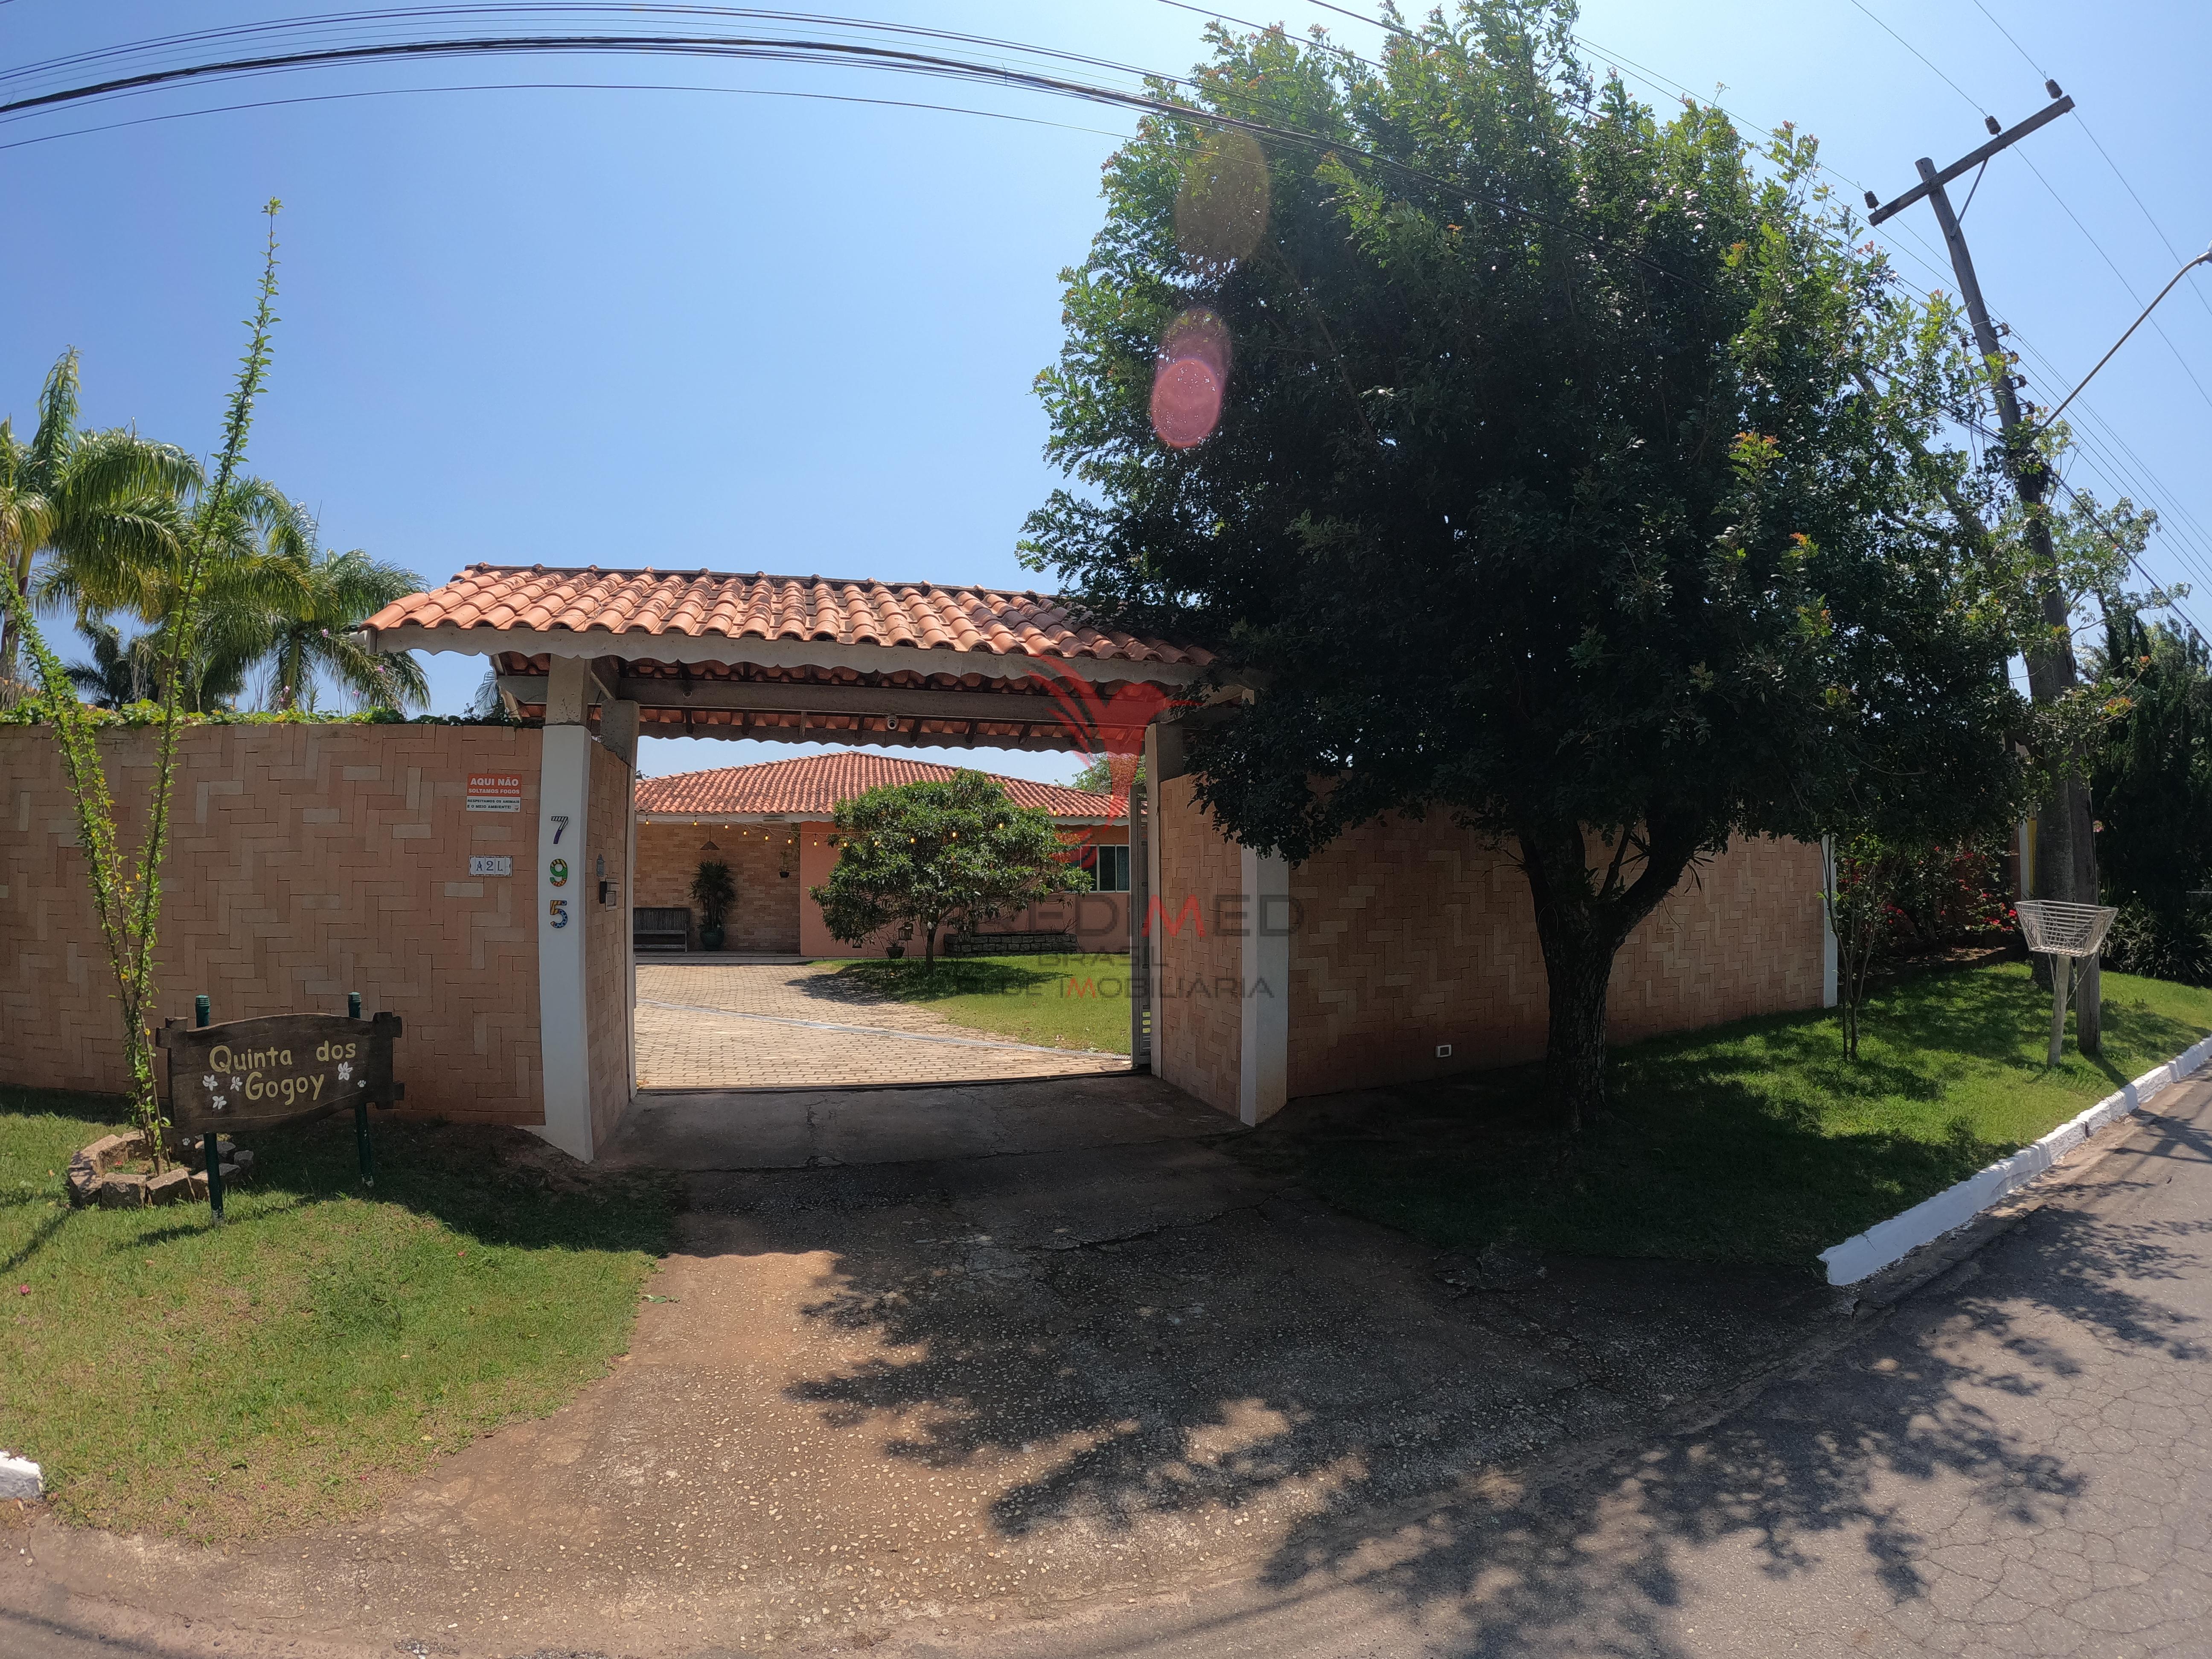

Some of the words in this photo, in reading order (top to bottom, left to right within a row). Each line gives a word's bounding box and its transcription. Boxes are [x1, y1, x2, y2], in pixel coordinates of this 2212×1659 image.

[470, 777, 495, 786] AQUI
[498, 777, 519, 786] NÃO
[210, 1045, 292, 1074] Quinta
[316, 1040, 356, 1061] dos
[244, 1071, 324, 1106] Gogoy
